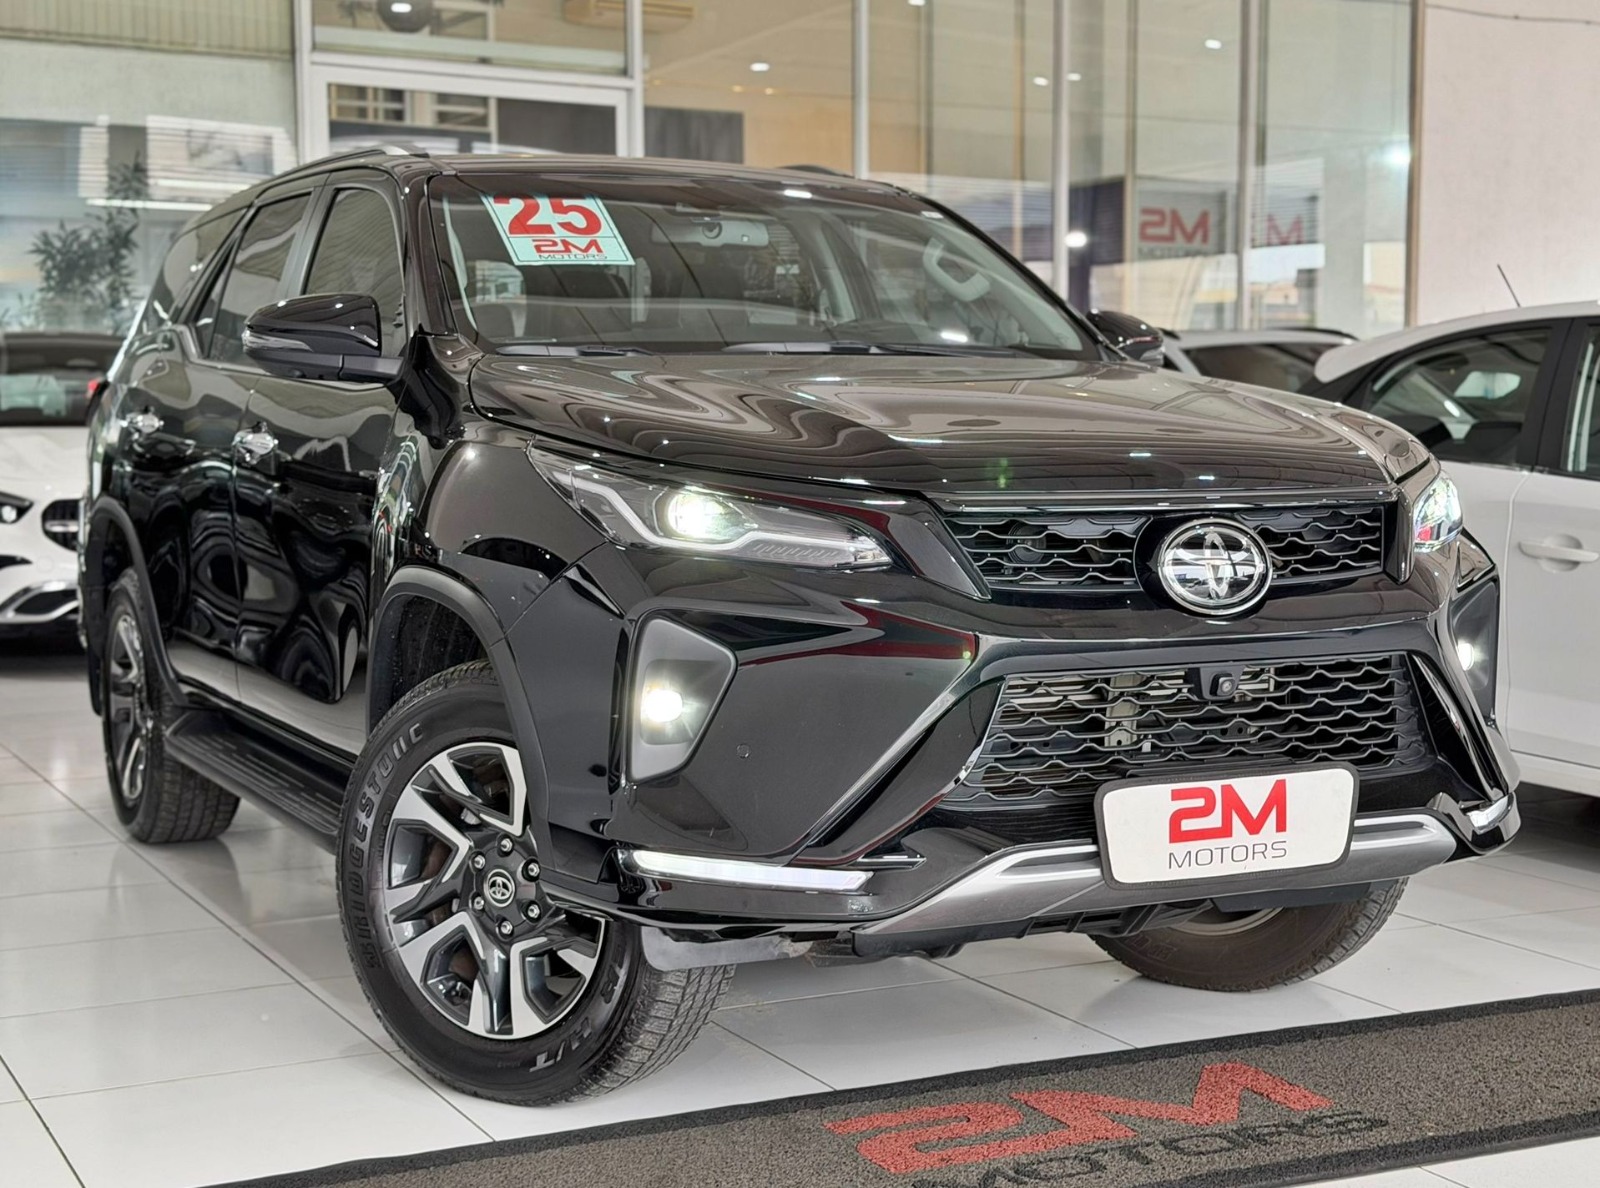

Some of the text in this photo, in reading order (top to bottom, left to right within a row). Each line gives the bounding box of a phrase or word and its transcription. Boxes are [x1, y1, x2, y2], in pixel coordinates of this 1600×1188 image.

[493, 195, 602, 236] 25
[1139, 207, 1210, 244] 2M
[532, 239, 604, 254] 2M
[1169, 779, 1287, 844] 2M
[1168, 840, 1287, 870] MOTORS
[823, 1061, 1334, 1174] 2M
